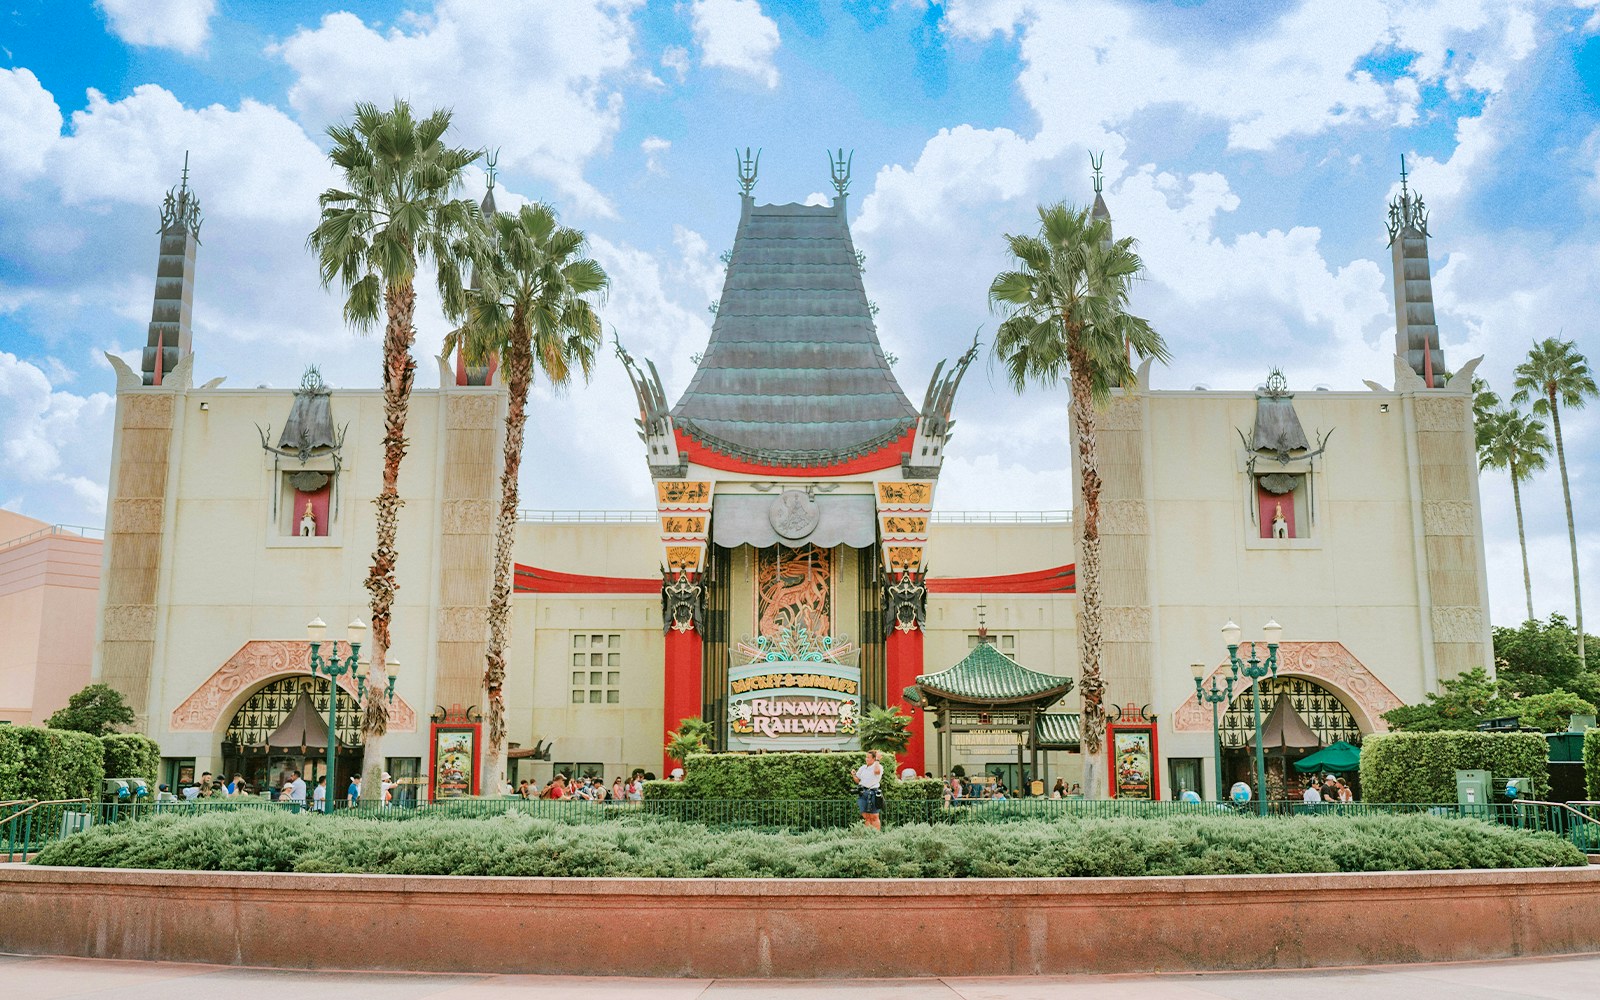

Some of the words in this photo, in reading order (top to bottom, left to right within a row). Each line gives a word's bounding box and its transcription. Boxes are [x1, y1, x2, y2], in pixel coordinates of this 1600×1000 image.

[731, 674, 783, 694] MICKEY
[784, 673, 795, 687] &
[751, 700, 842, 716] RUNAWAY
[753, 717, 839, 738] RAILWAY
